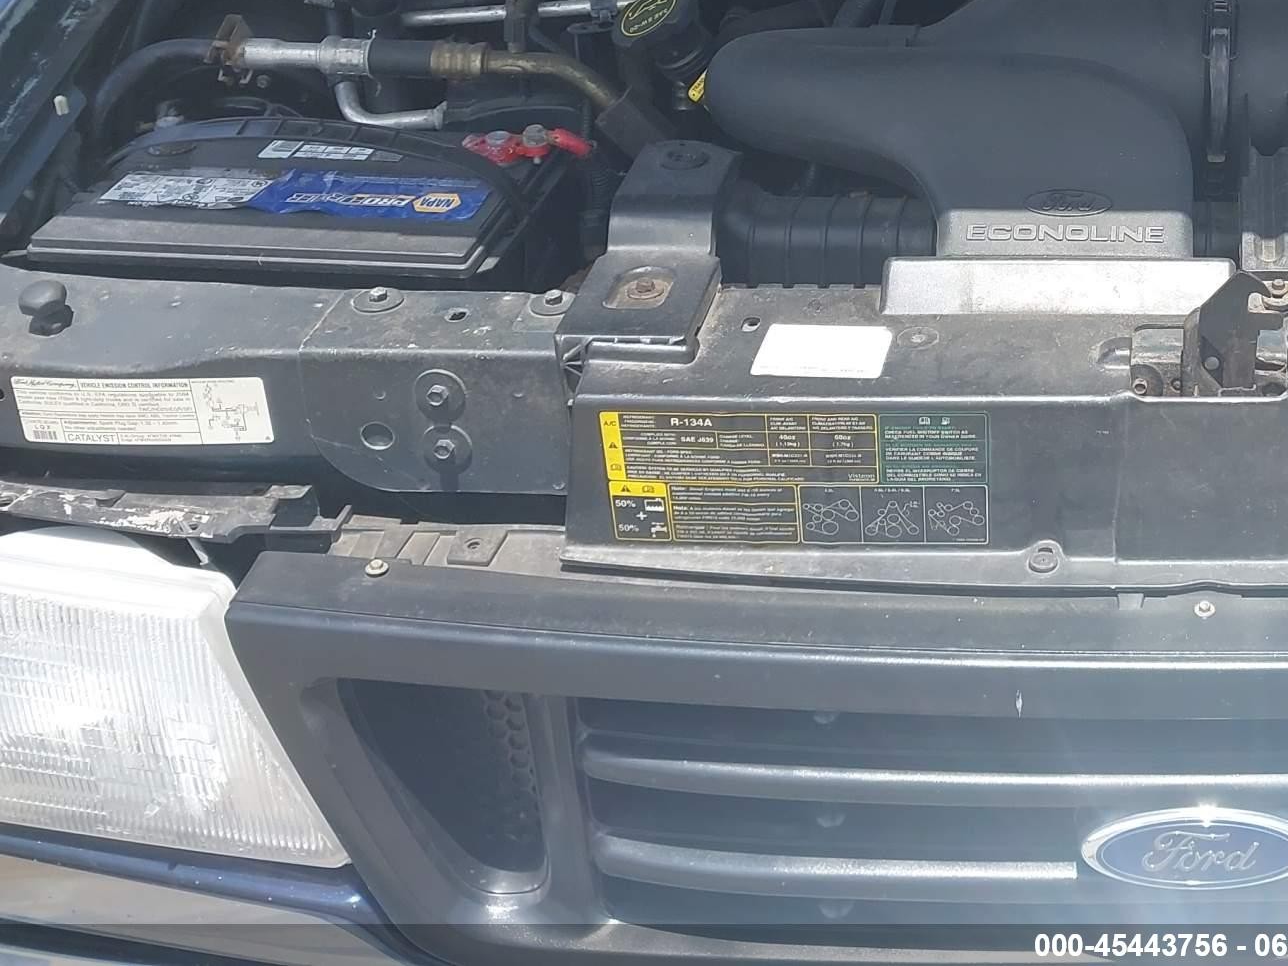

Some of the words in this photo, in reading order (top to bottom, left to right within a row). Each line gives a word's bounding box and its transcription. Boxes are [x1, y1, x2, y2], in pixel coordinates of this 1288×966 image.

[420, 197, 454, 209] NAPA
[1040, 191, 1096, 212] Ford
[965, 224, 1165, 243] ECONOLINE
[670, 417, 713, 427] R-134A
[67, 433, 116, 443] CATALYST
[680, 435, 696, 443] SAE
[615, 499, 636, 508] 50%
[618, 523, 639, 532] 50%
[1142, 830, 1260, 872] Ford
